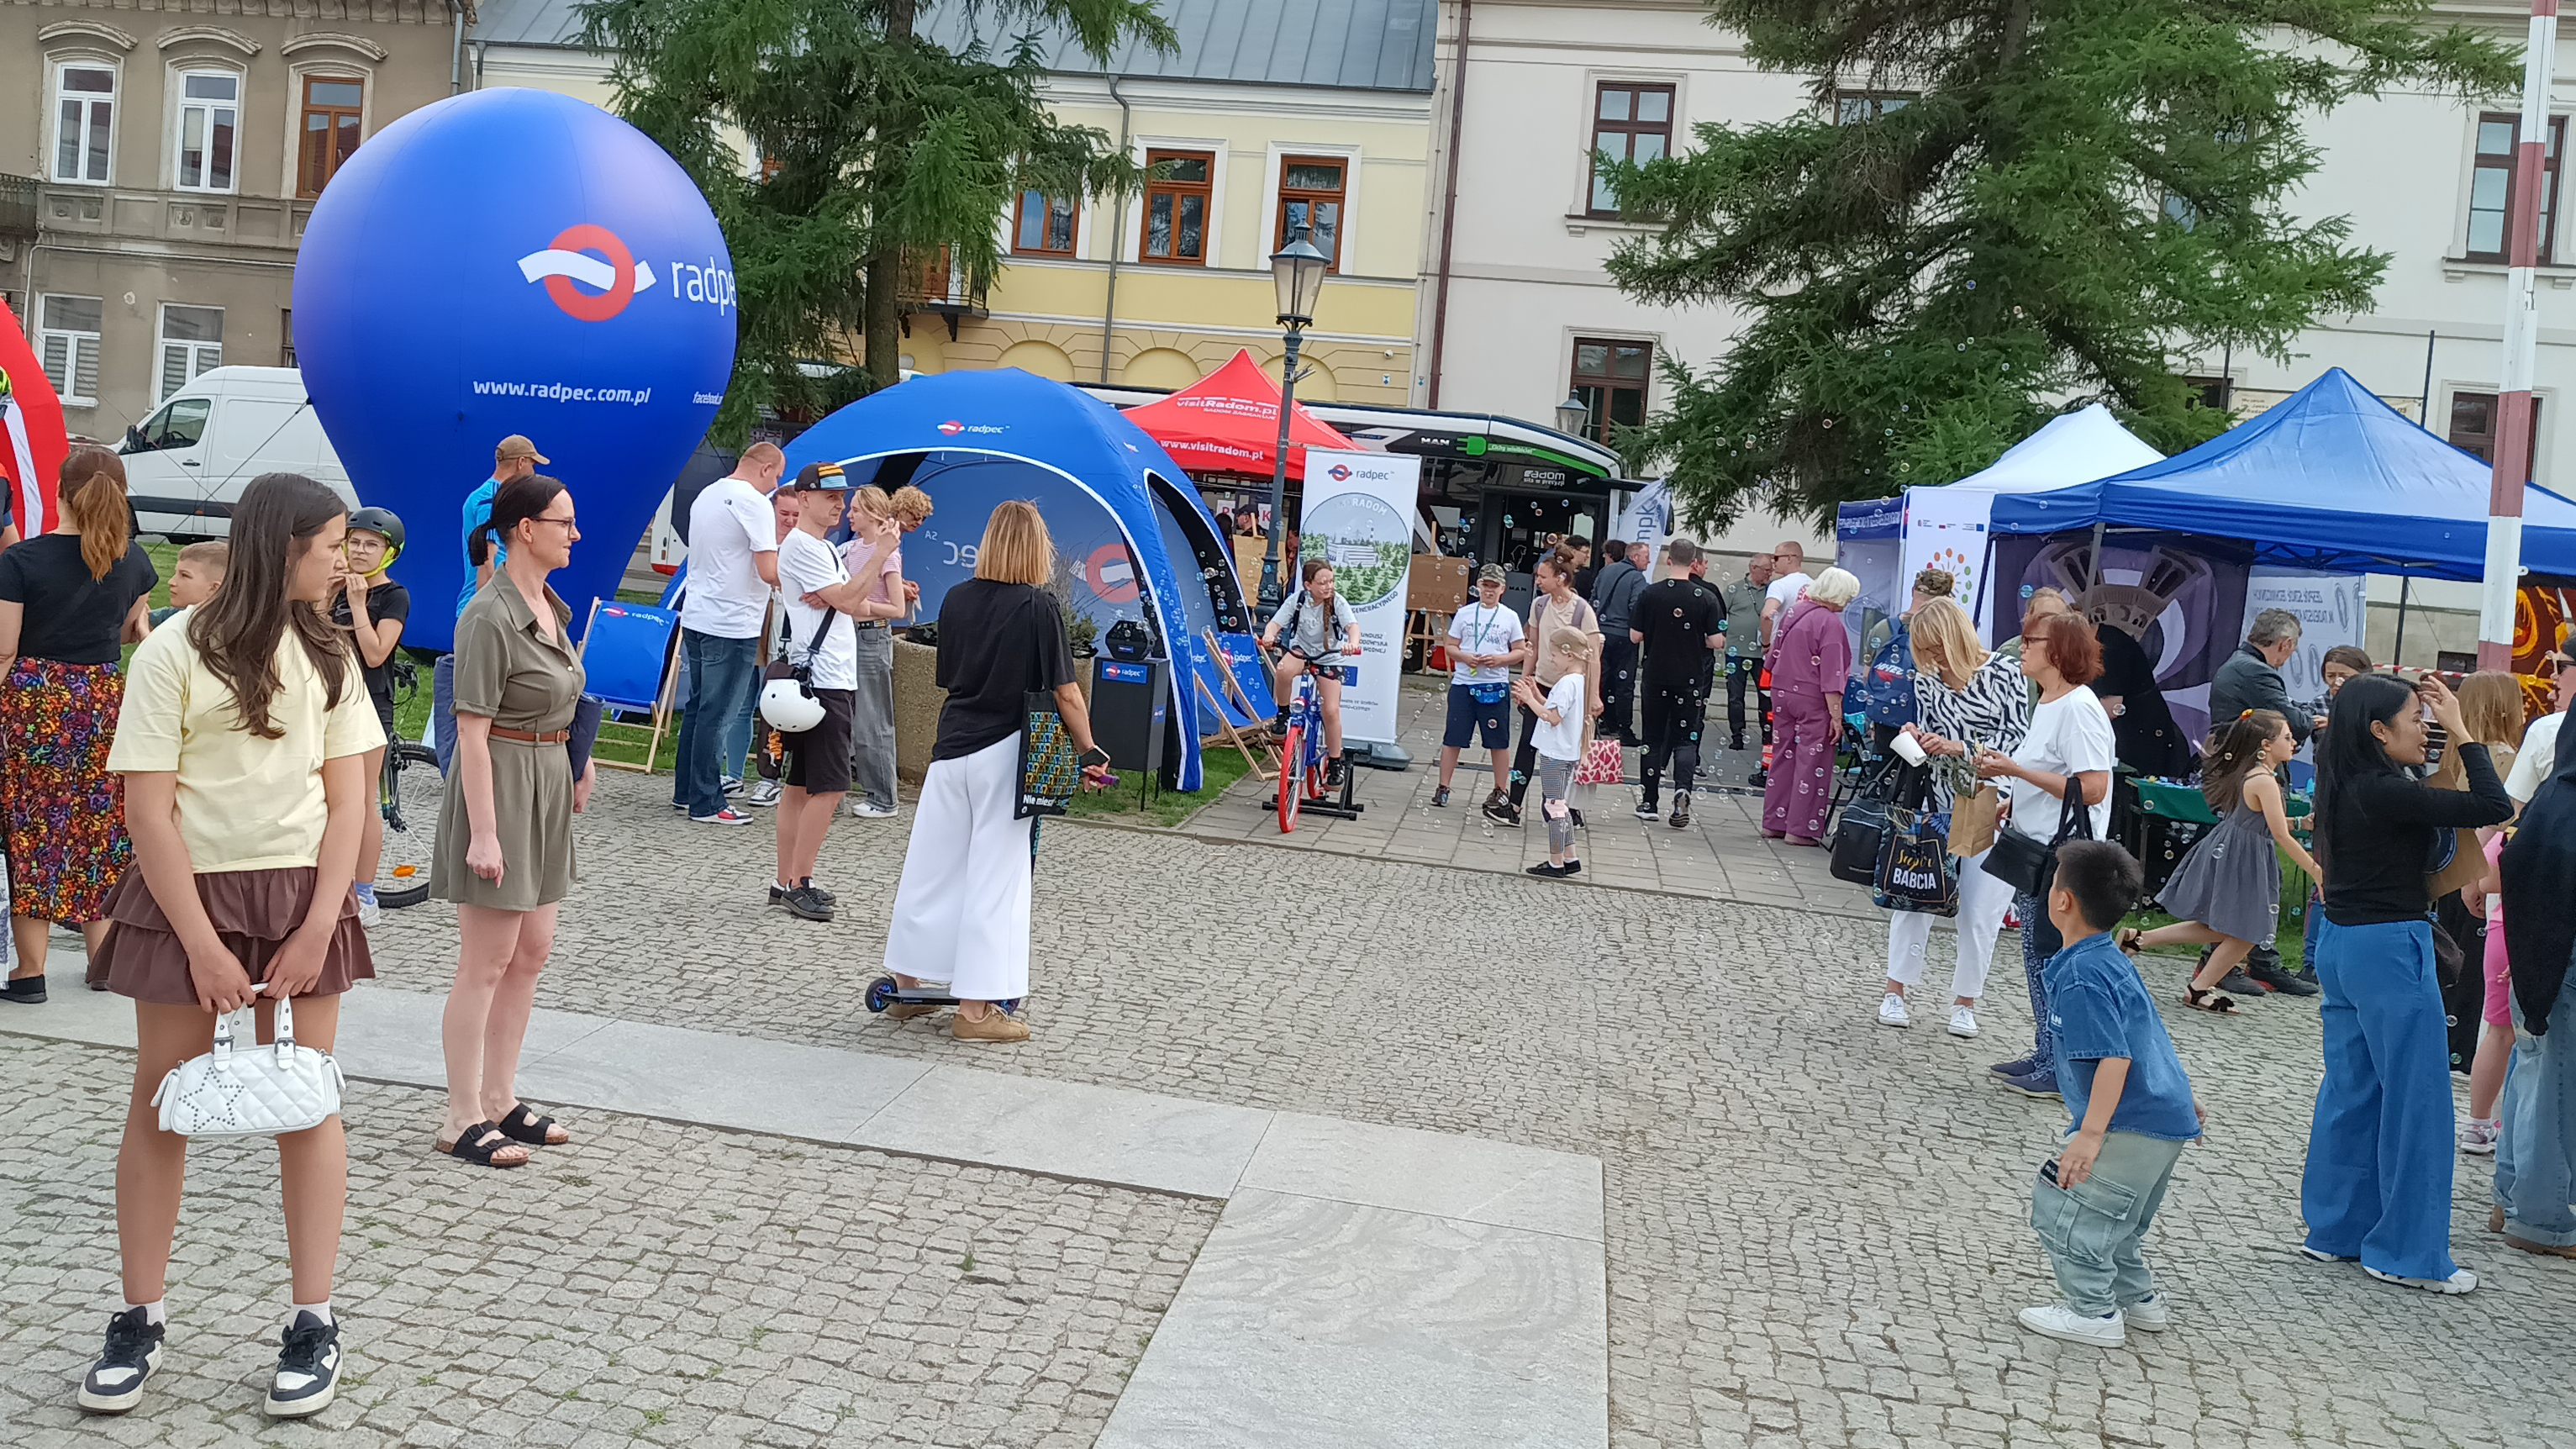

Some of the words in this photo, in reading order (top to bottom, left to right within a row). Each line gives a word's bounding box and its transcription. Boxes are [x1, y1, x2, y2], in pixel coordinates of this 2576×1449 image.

[672, 256, 736, 317] radpe
[472, 381, 651, 406] www.radpec.com.pl
[967, 424, 1005, 435] radpec
[1420, 436, 1451, 446] MAN
[1159, 440, 1264, 461] www.visitradom.pl
[1356, 469, 1390, 482] radpec
[632, 612, 665, 626] radpec
[1893, 867, 1937, 890] BABCIA
